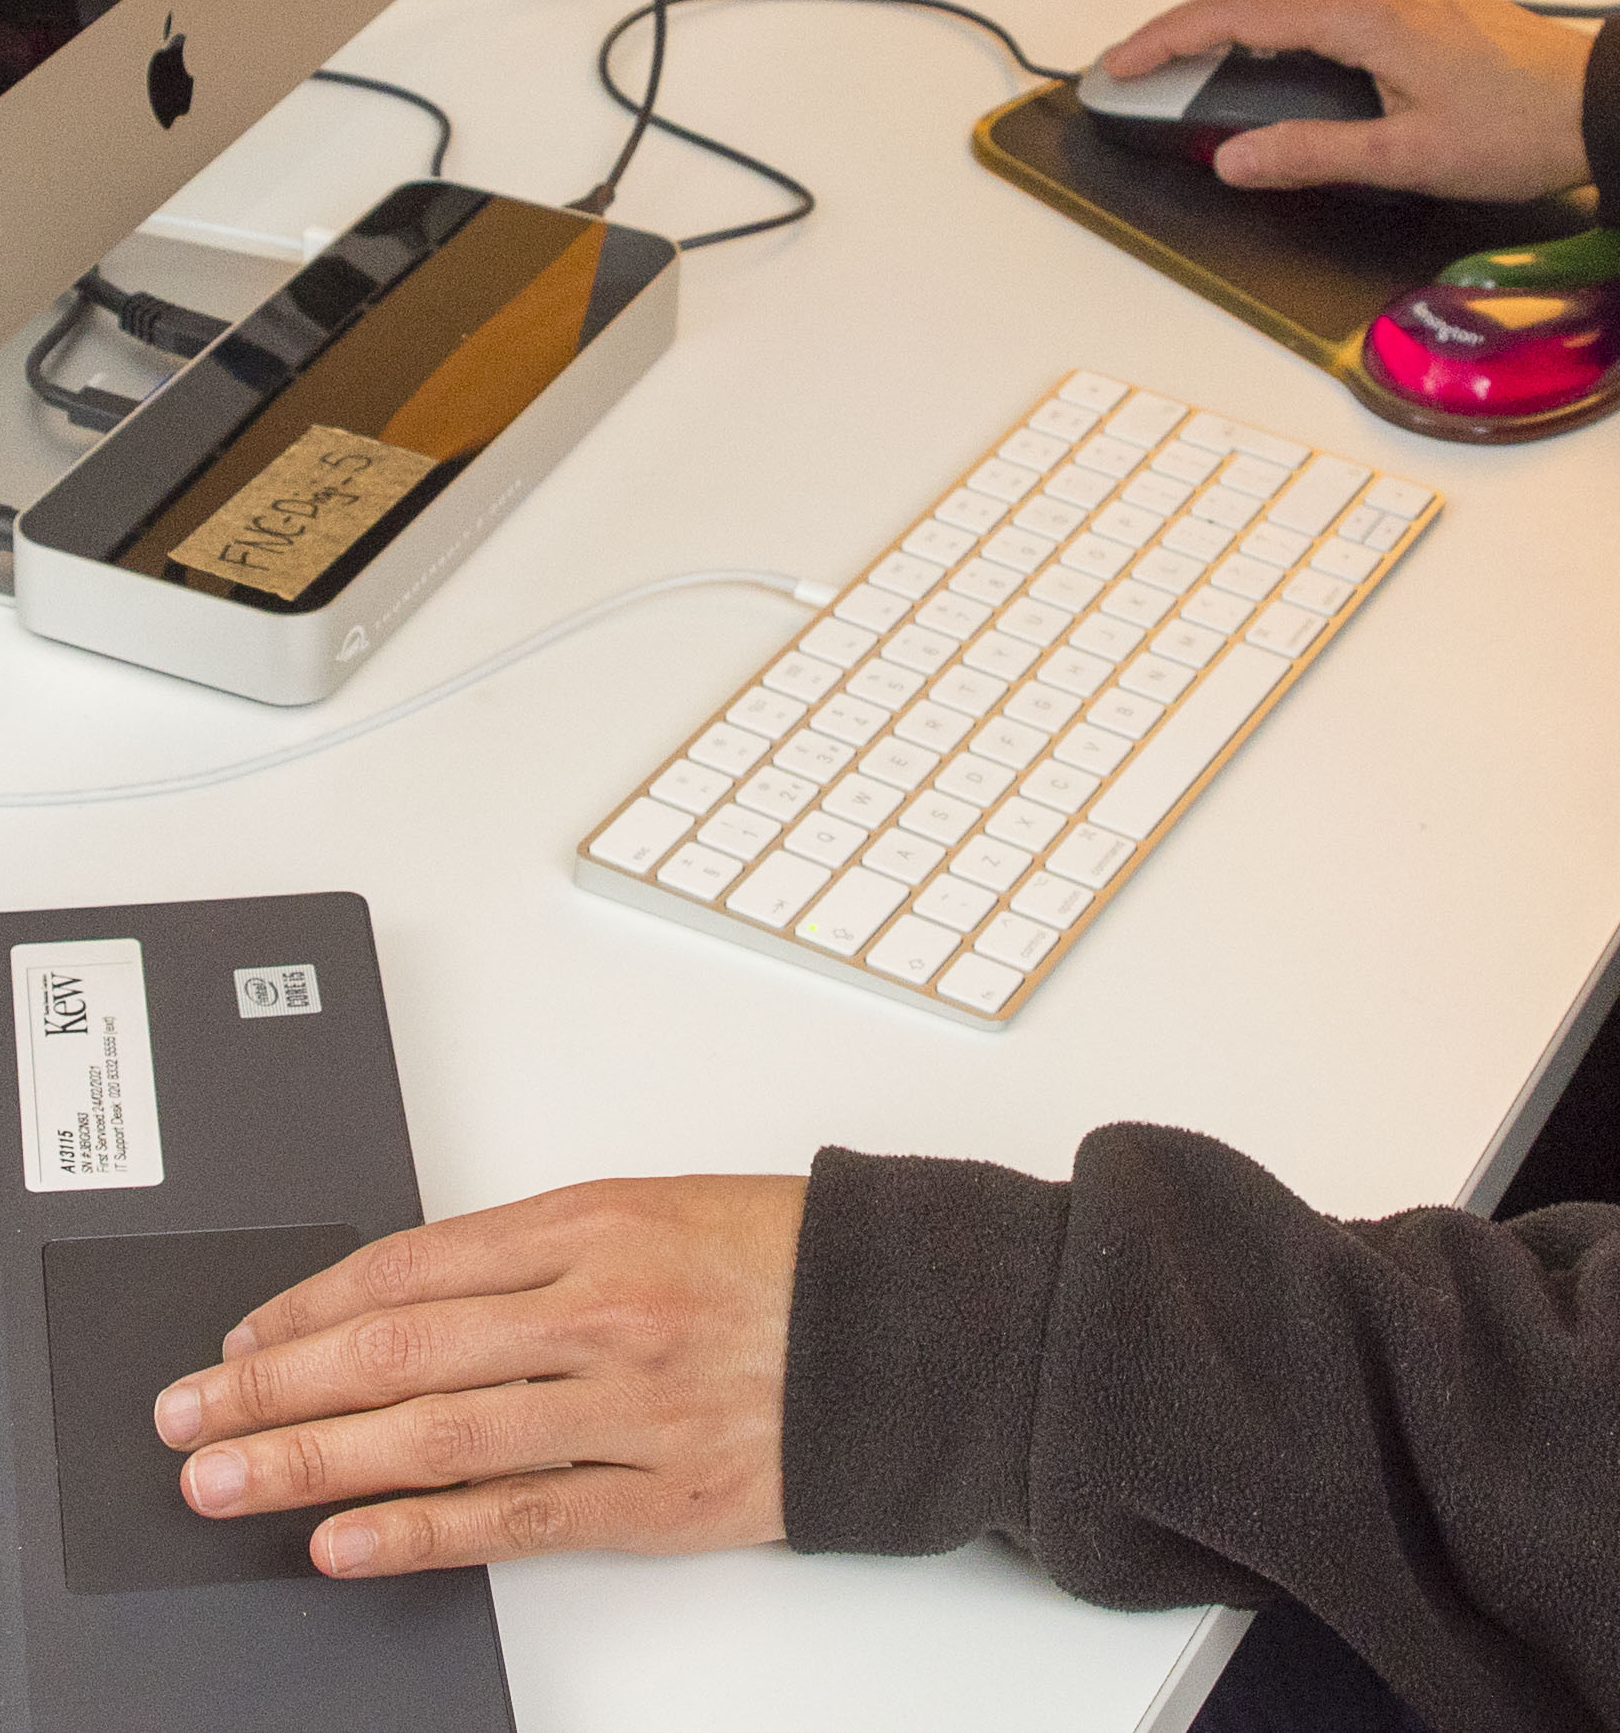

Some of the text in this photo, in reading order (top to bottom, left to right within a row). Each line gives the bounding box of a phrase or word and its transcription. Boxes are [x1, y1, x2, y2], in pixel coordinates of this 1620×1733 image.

[44, 972, 88, 1036] Kew
[284, 983, 309, 1007] CORE
[104, 1037, 117, 1057] 5555
[107, 1083, 121, 1098] 020
[91, 1114, 107, 1151] Serviced
[110, 1127, 128, 1160] Support
[58, 1130, 75, 1174] A13115
[95, 1153, 109, 1172] First
[82, 1161, 93, 1174] SN
[114, 1163, 128, 1172] IT
